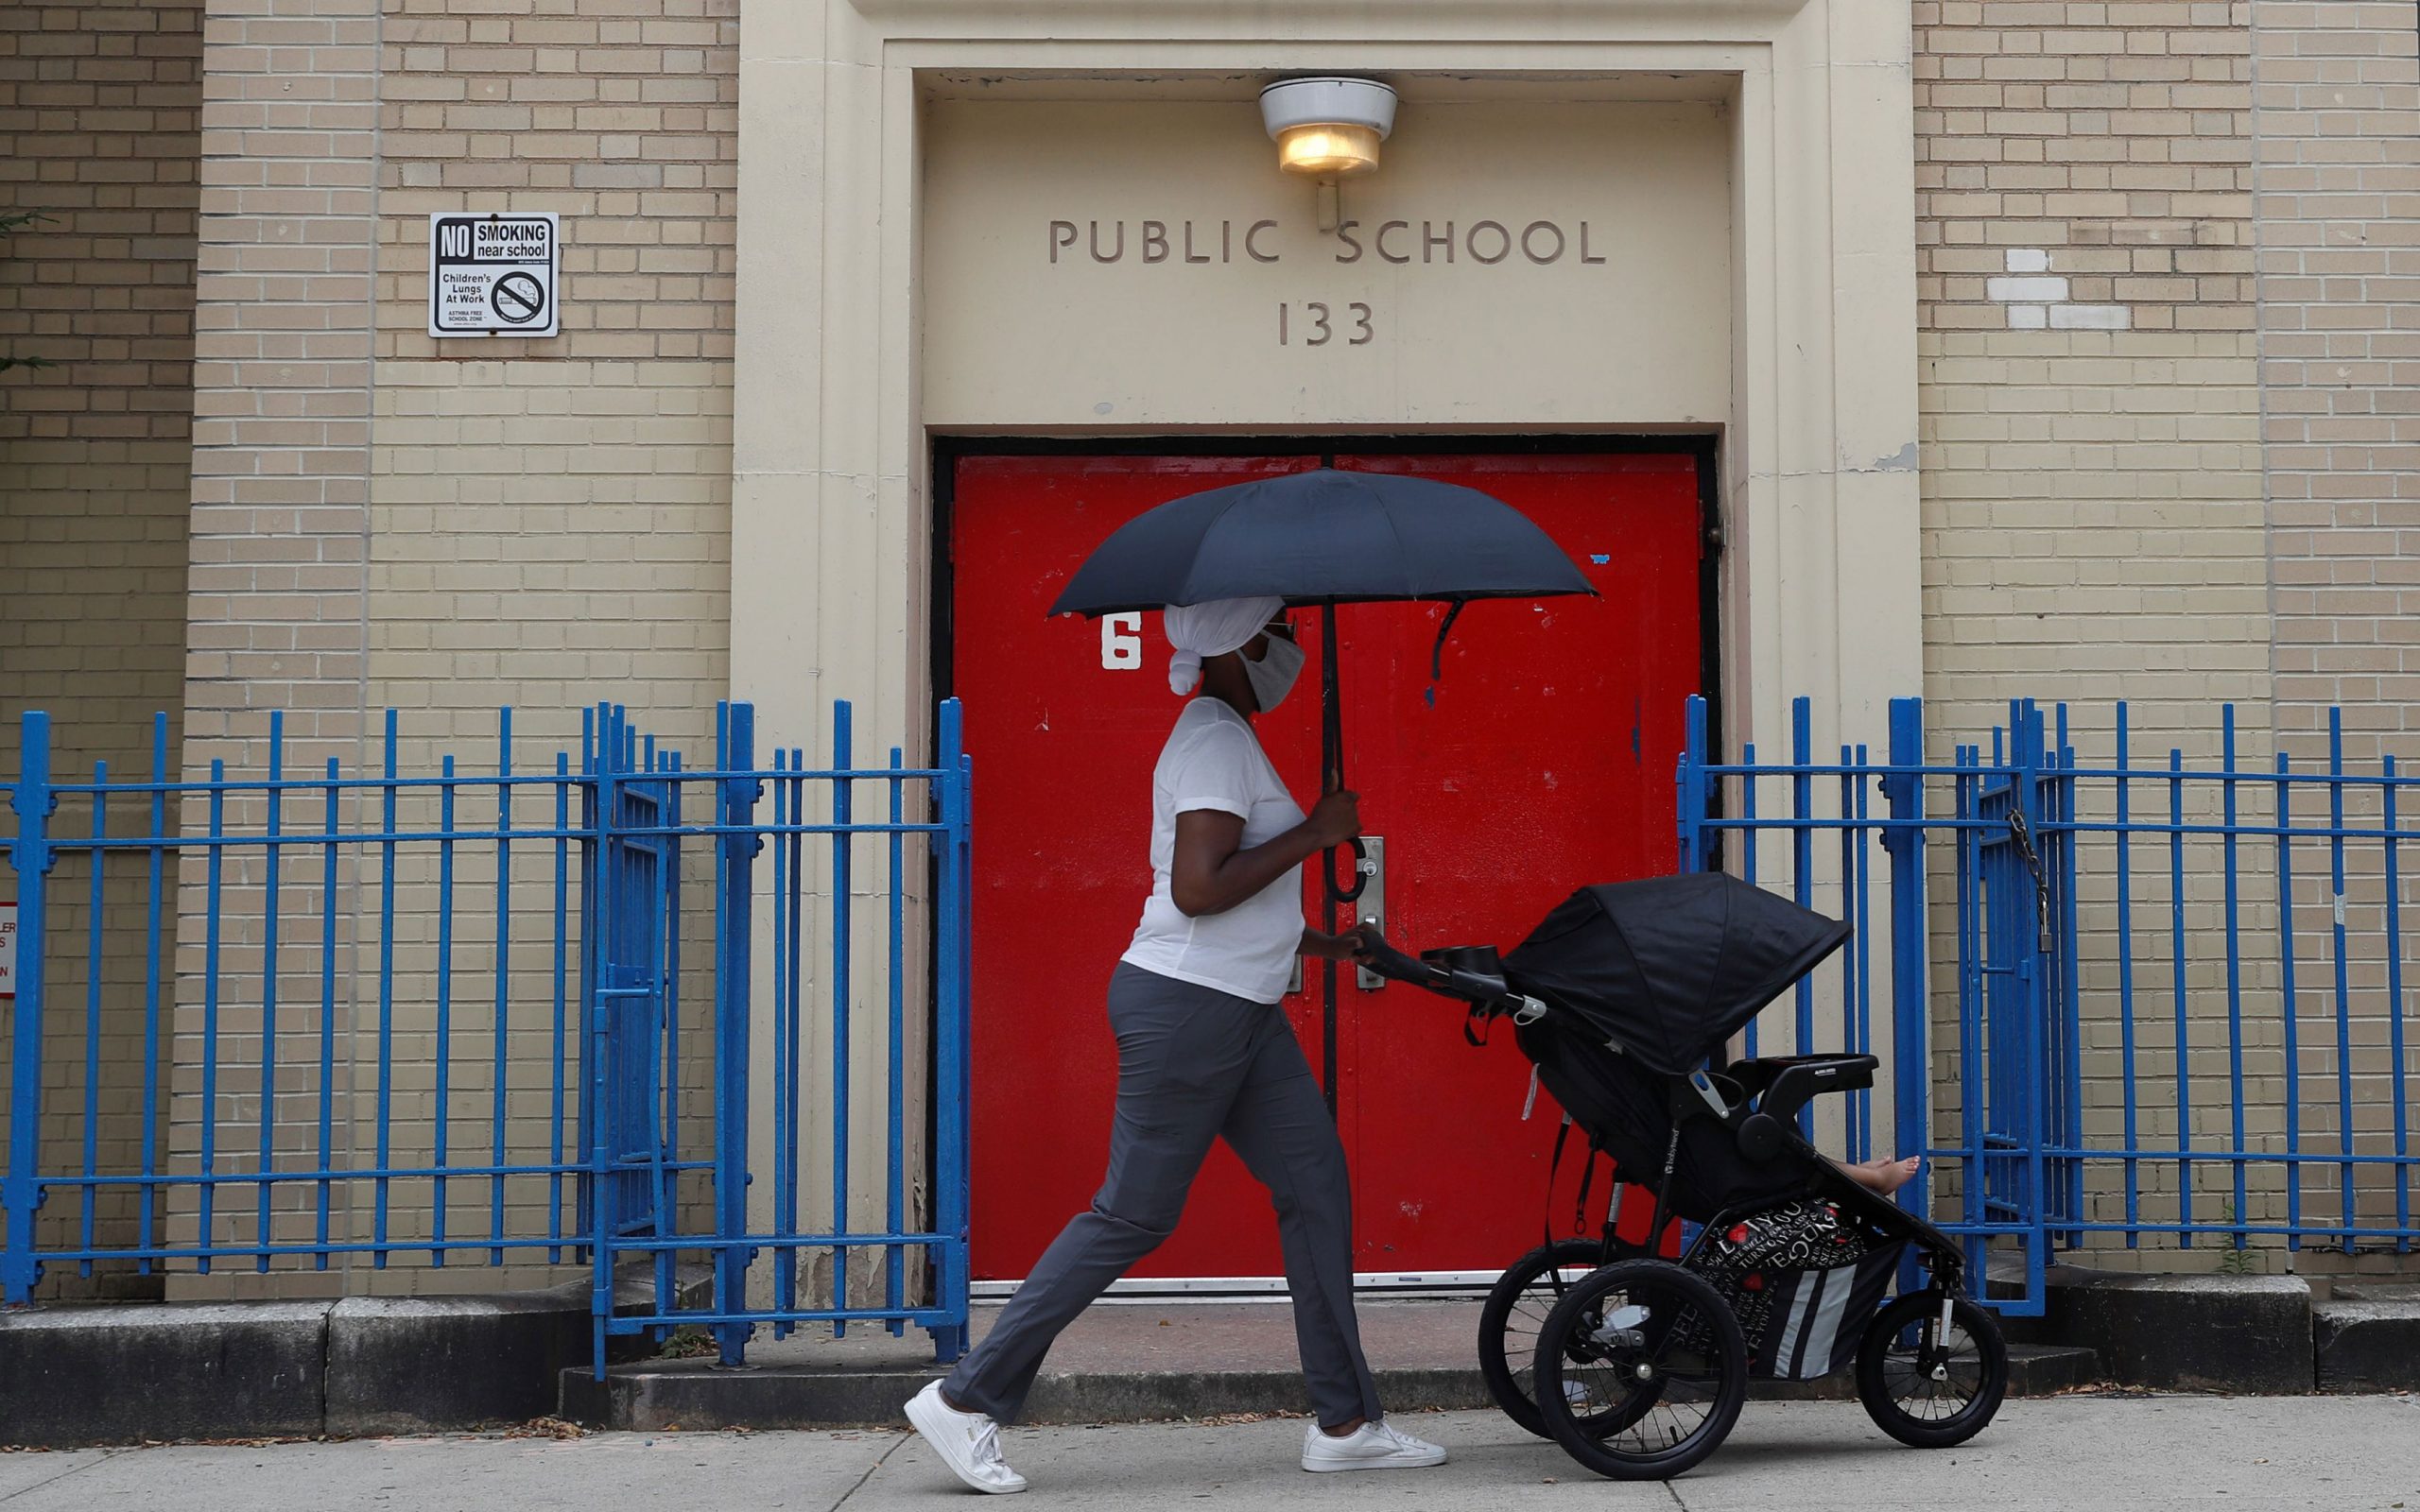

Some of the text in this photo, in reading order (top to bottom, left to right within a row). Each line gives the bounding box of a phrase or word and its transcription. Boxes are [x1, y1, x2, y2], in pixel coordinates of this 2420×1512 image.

[441, 224, 545, 258] NO SMOKING
[477, 243, 545, 257] near school
[1048, 219, 1607, 266] PUBLIC SCHOOL
[442, 273, 492, 284] Children's
[452, 284, 482, 295] Lungs
[446, 295, 485, 303] At Work
[1279, 301, 1374, 347] 133
[1101, 610, 1142, 670] 6
